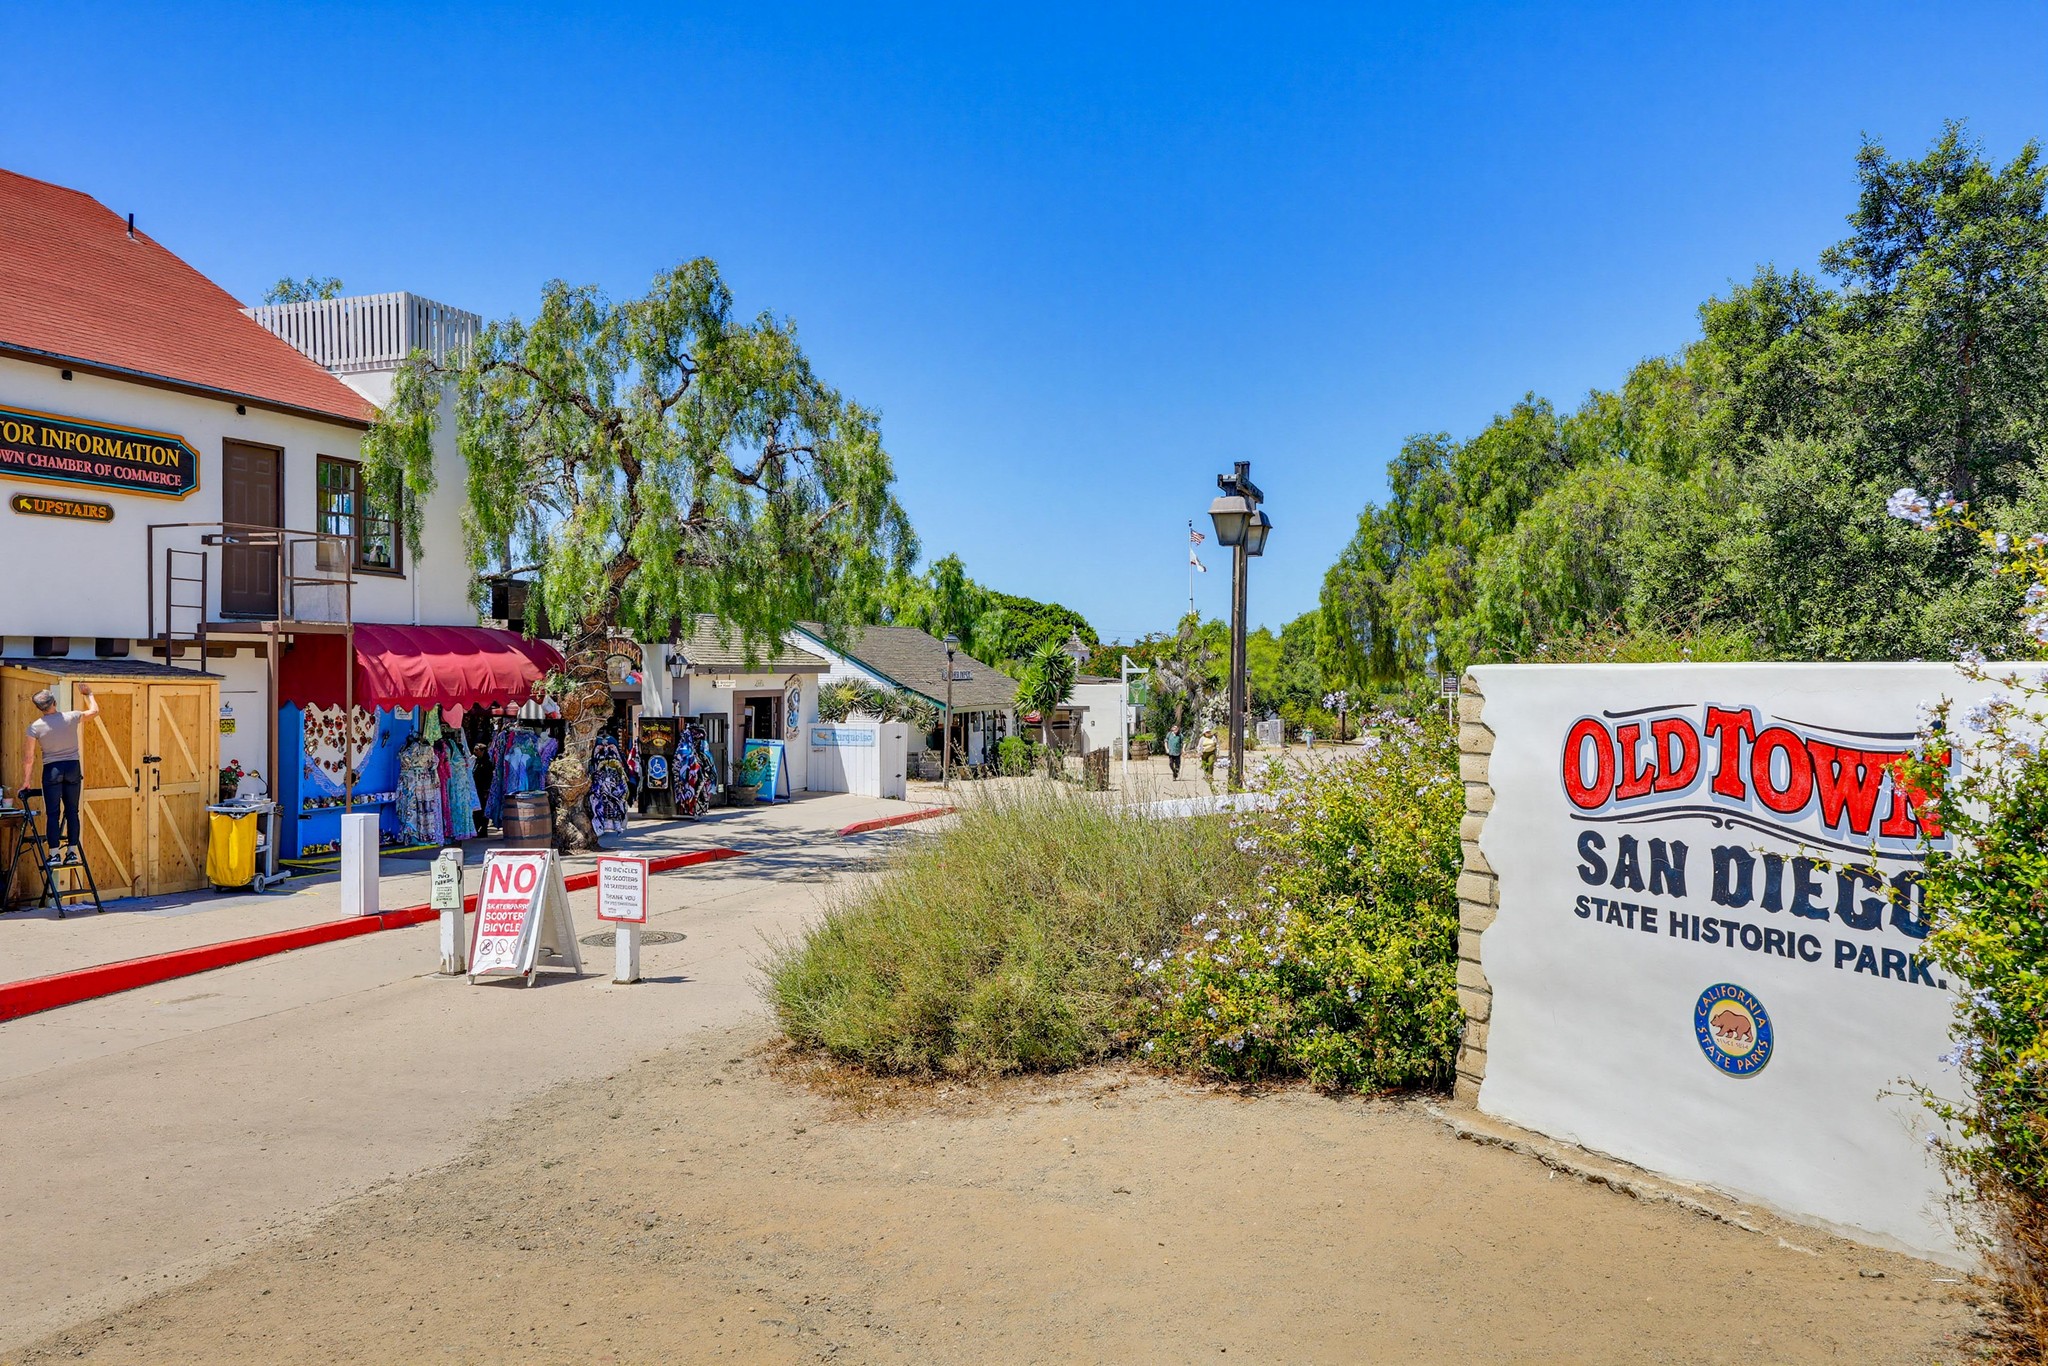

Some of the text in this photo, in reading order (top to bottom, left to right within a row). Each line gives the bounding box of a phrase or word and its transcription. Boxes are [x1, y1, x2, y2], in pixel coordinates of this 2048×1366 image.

[40, 427, 180, 468] INFORMATION
[26, 453, 93, 474] CHAMBER
[94, 463, 112, 477] OF
[113, 466, 182, 487] COMMERCE
[34, 499, 108, 519] UPSTAIRS
[1562, 705, 1953, 840] OLD TOWN
[488, 863, 537, 894] NO
[1576, 830, 1931, 940] SAN DIEGO
[1573, 894, 1948, 991] STATE HISTORIC PARK.
[1697, 985, 1767, 1029] CALIFORNIA
[1697, 1026, 1769, 1071] STATE PARKS
